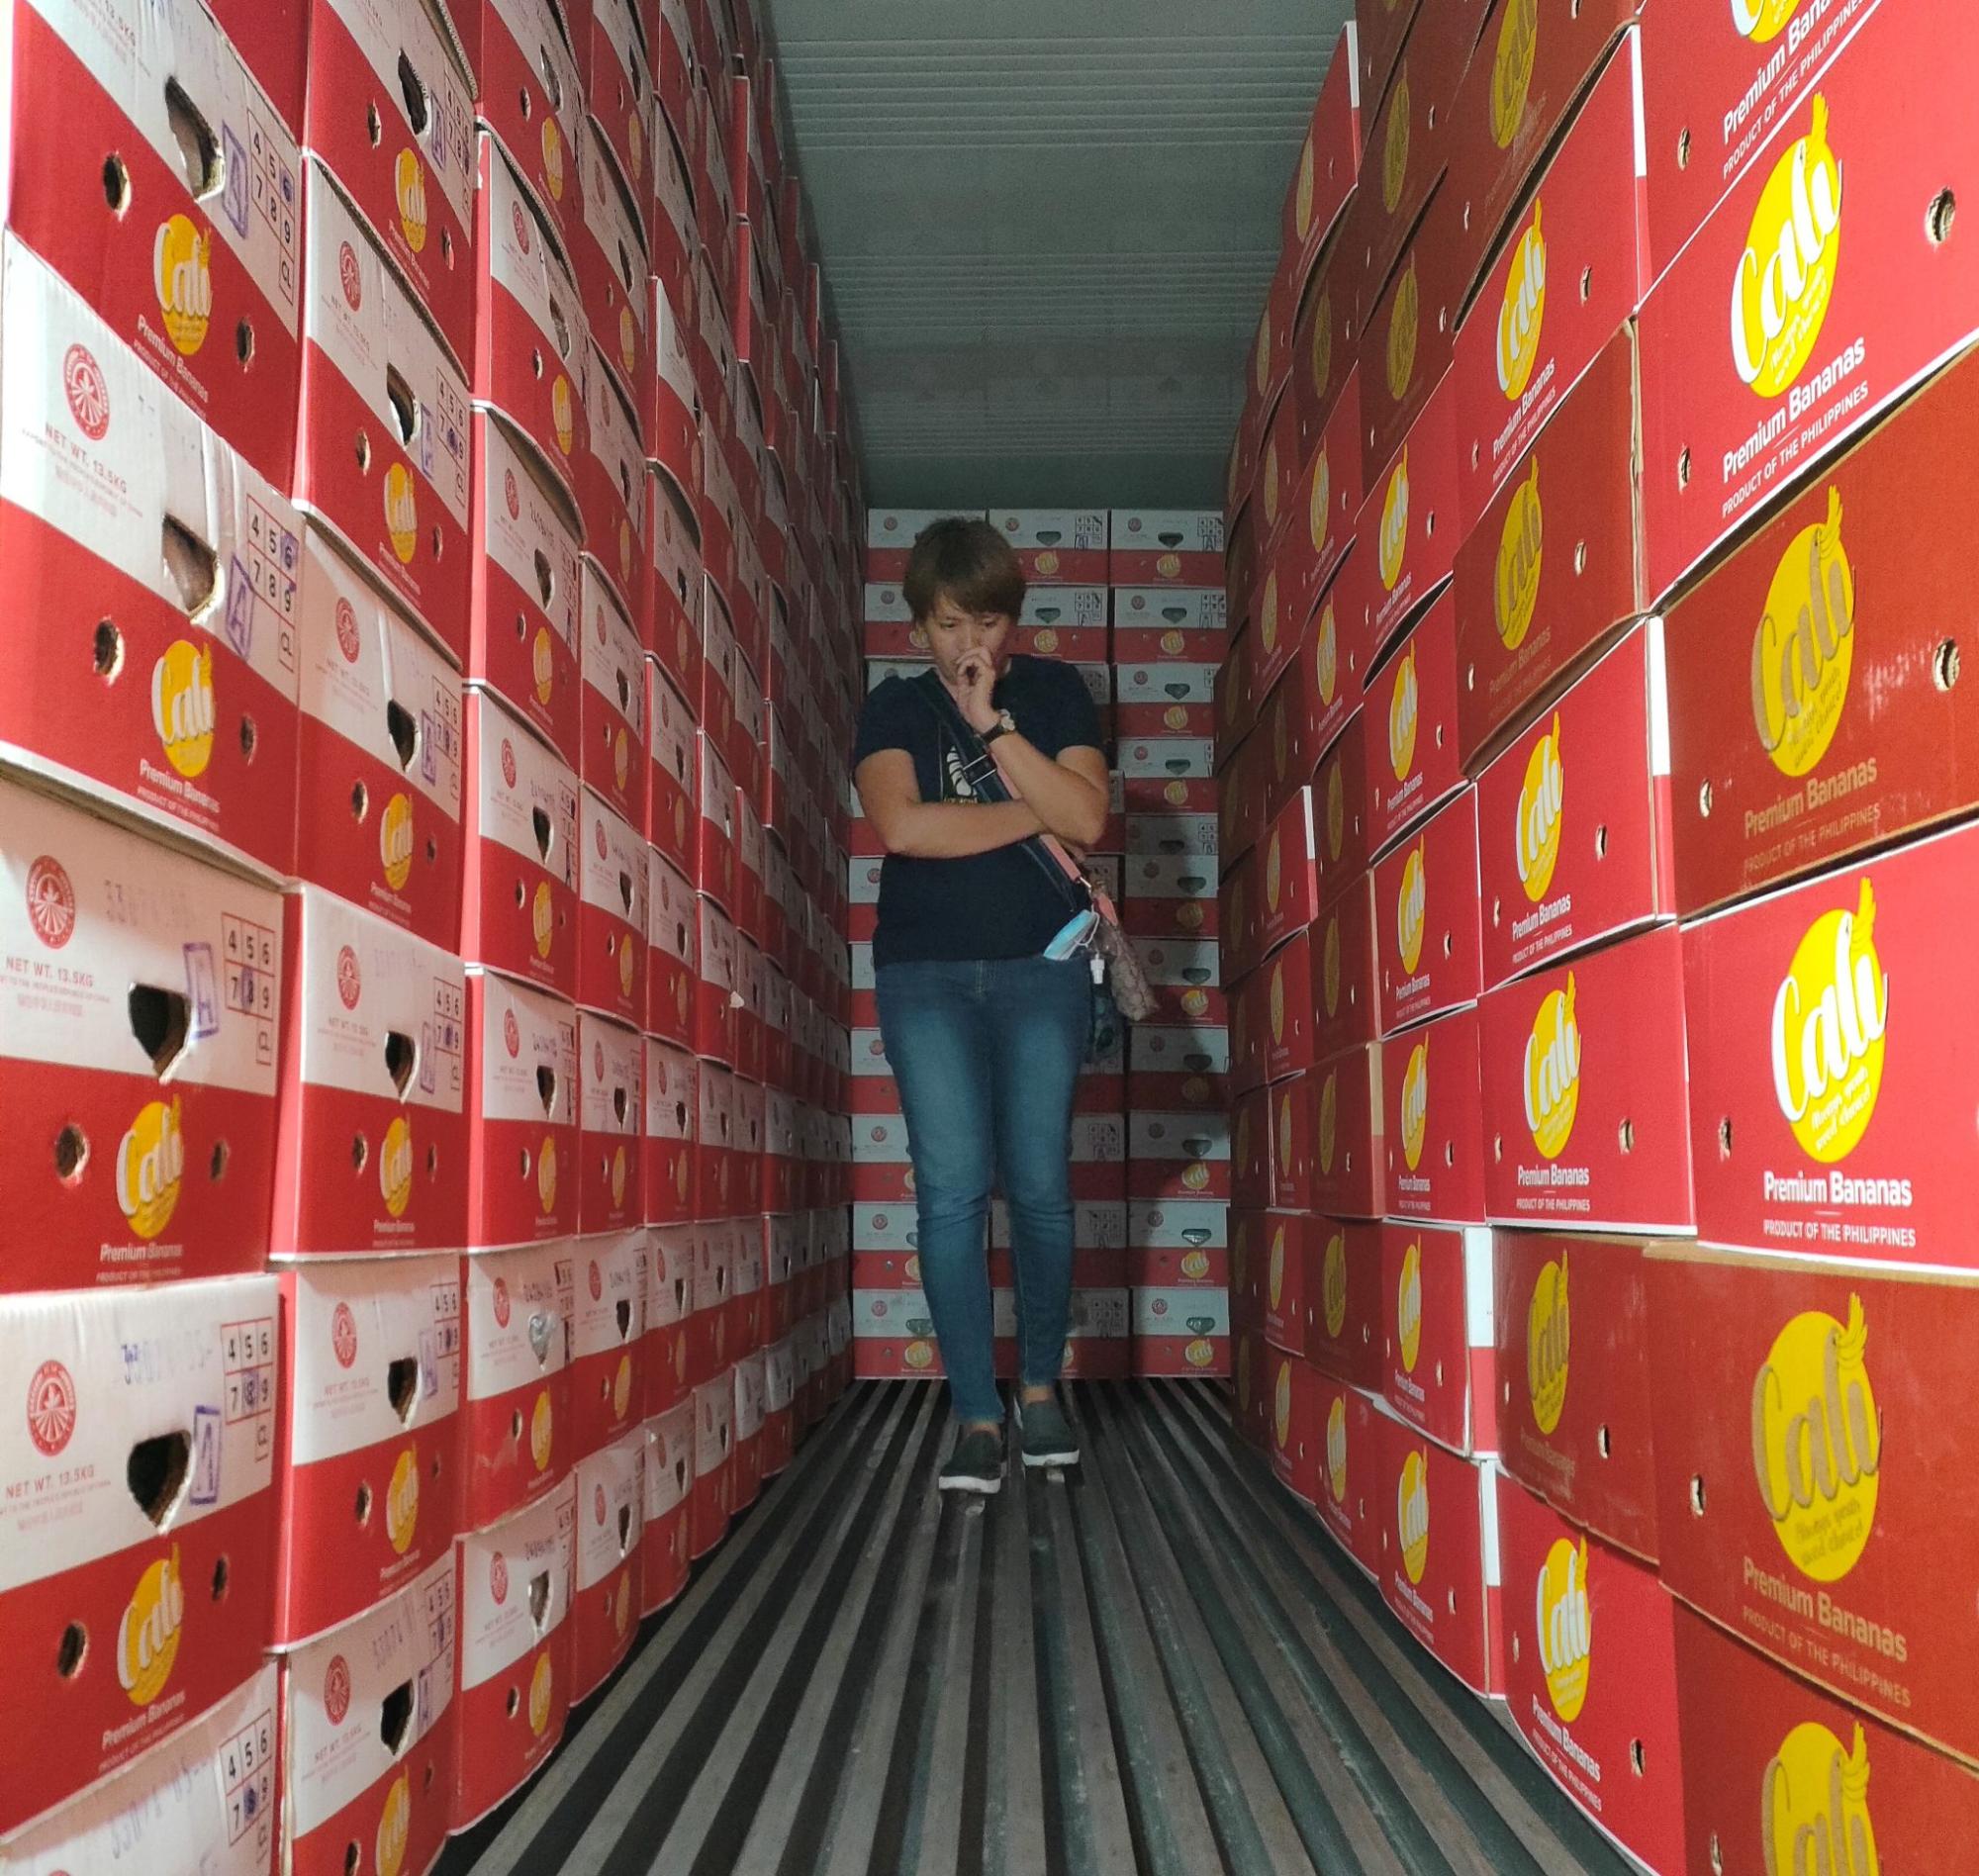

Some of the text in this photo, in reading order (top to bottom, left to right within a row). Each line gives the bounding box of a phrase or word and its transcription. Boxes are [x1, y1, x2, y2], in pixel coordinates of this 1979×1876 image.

[1723, 0, 1863, 181] PRODUCT OF THE PHILIPPINE
[1724, 45, 1787, 145] Premium
[1788, 0, 1832, 55] Bana
[252, 129, 262, 155] 4
[267, 154, 277, 180] 5
[254, 173, 293, 245] 7 8 9
[137, 313, 177, 368] Premium
[1723, 336, 1866, 485] Premium Bananas
[45, 422, 67, 449] NET
[1722, 380, 1868, 517] PRODUCT OF THE PHILIPPINES
[251, 513, 260, 538] 4
[268, 526, 278, 554] 5
[253, 558, 292, 613] 7 8 9
[140, 758, 182, 796] Premium
[1743, 757, 1879, 839] Premium Bananas
[1796, 827, 1818, 849] THE
[1819, 802, 1881, 842] PHILIPPINES
[1512, 893, 1571, 942] Premium Bananas
[6, 955, 30, 974] NET
[228, 929, 237, 954] 4
[245, 935, 254, 960] 5
[231, 976, 238, 1000] 7
[261, 985, 270, 1009] 9
[1517, 1164, 1590, 1186] Premium Bananas
[1763, 1170, 1913, 1207] Premium Bananas
[100, 1243, 146, 1263] Premium
[1763, 1218, 1916, 1247] PRODUCT OF THE PHILIPPINES
[228, 1338, 236, 1361] 4
[245, 1335, 253, 1360] 5
[231, 1386, 238, 1412] 7
[6, 1479, 30, 1498] NET
[1743, 1555, 1908, 1663] Premium Bananas
[1788, 1632, 1804, 1650] OF
[1807, 1639, 1830, 1667] THE
[1832, 1652, 1912, 1709] PHILIPPINES
[102, 1707, 147, 1750] Premium
[228, 1729, 268, 1779] 4 5 6
[233, 1802, 240, 1830] 7
